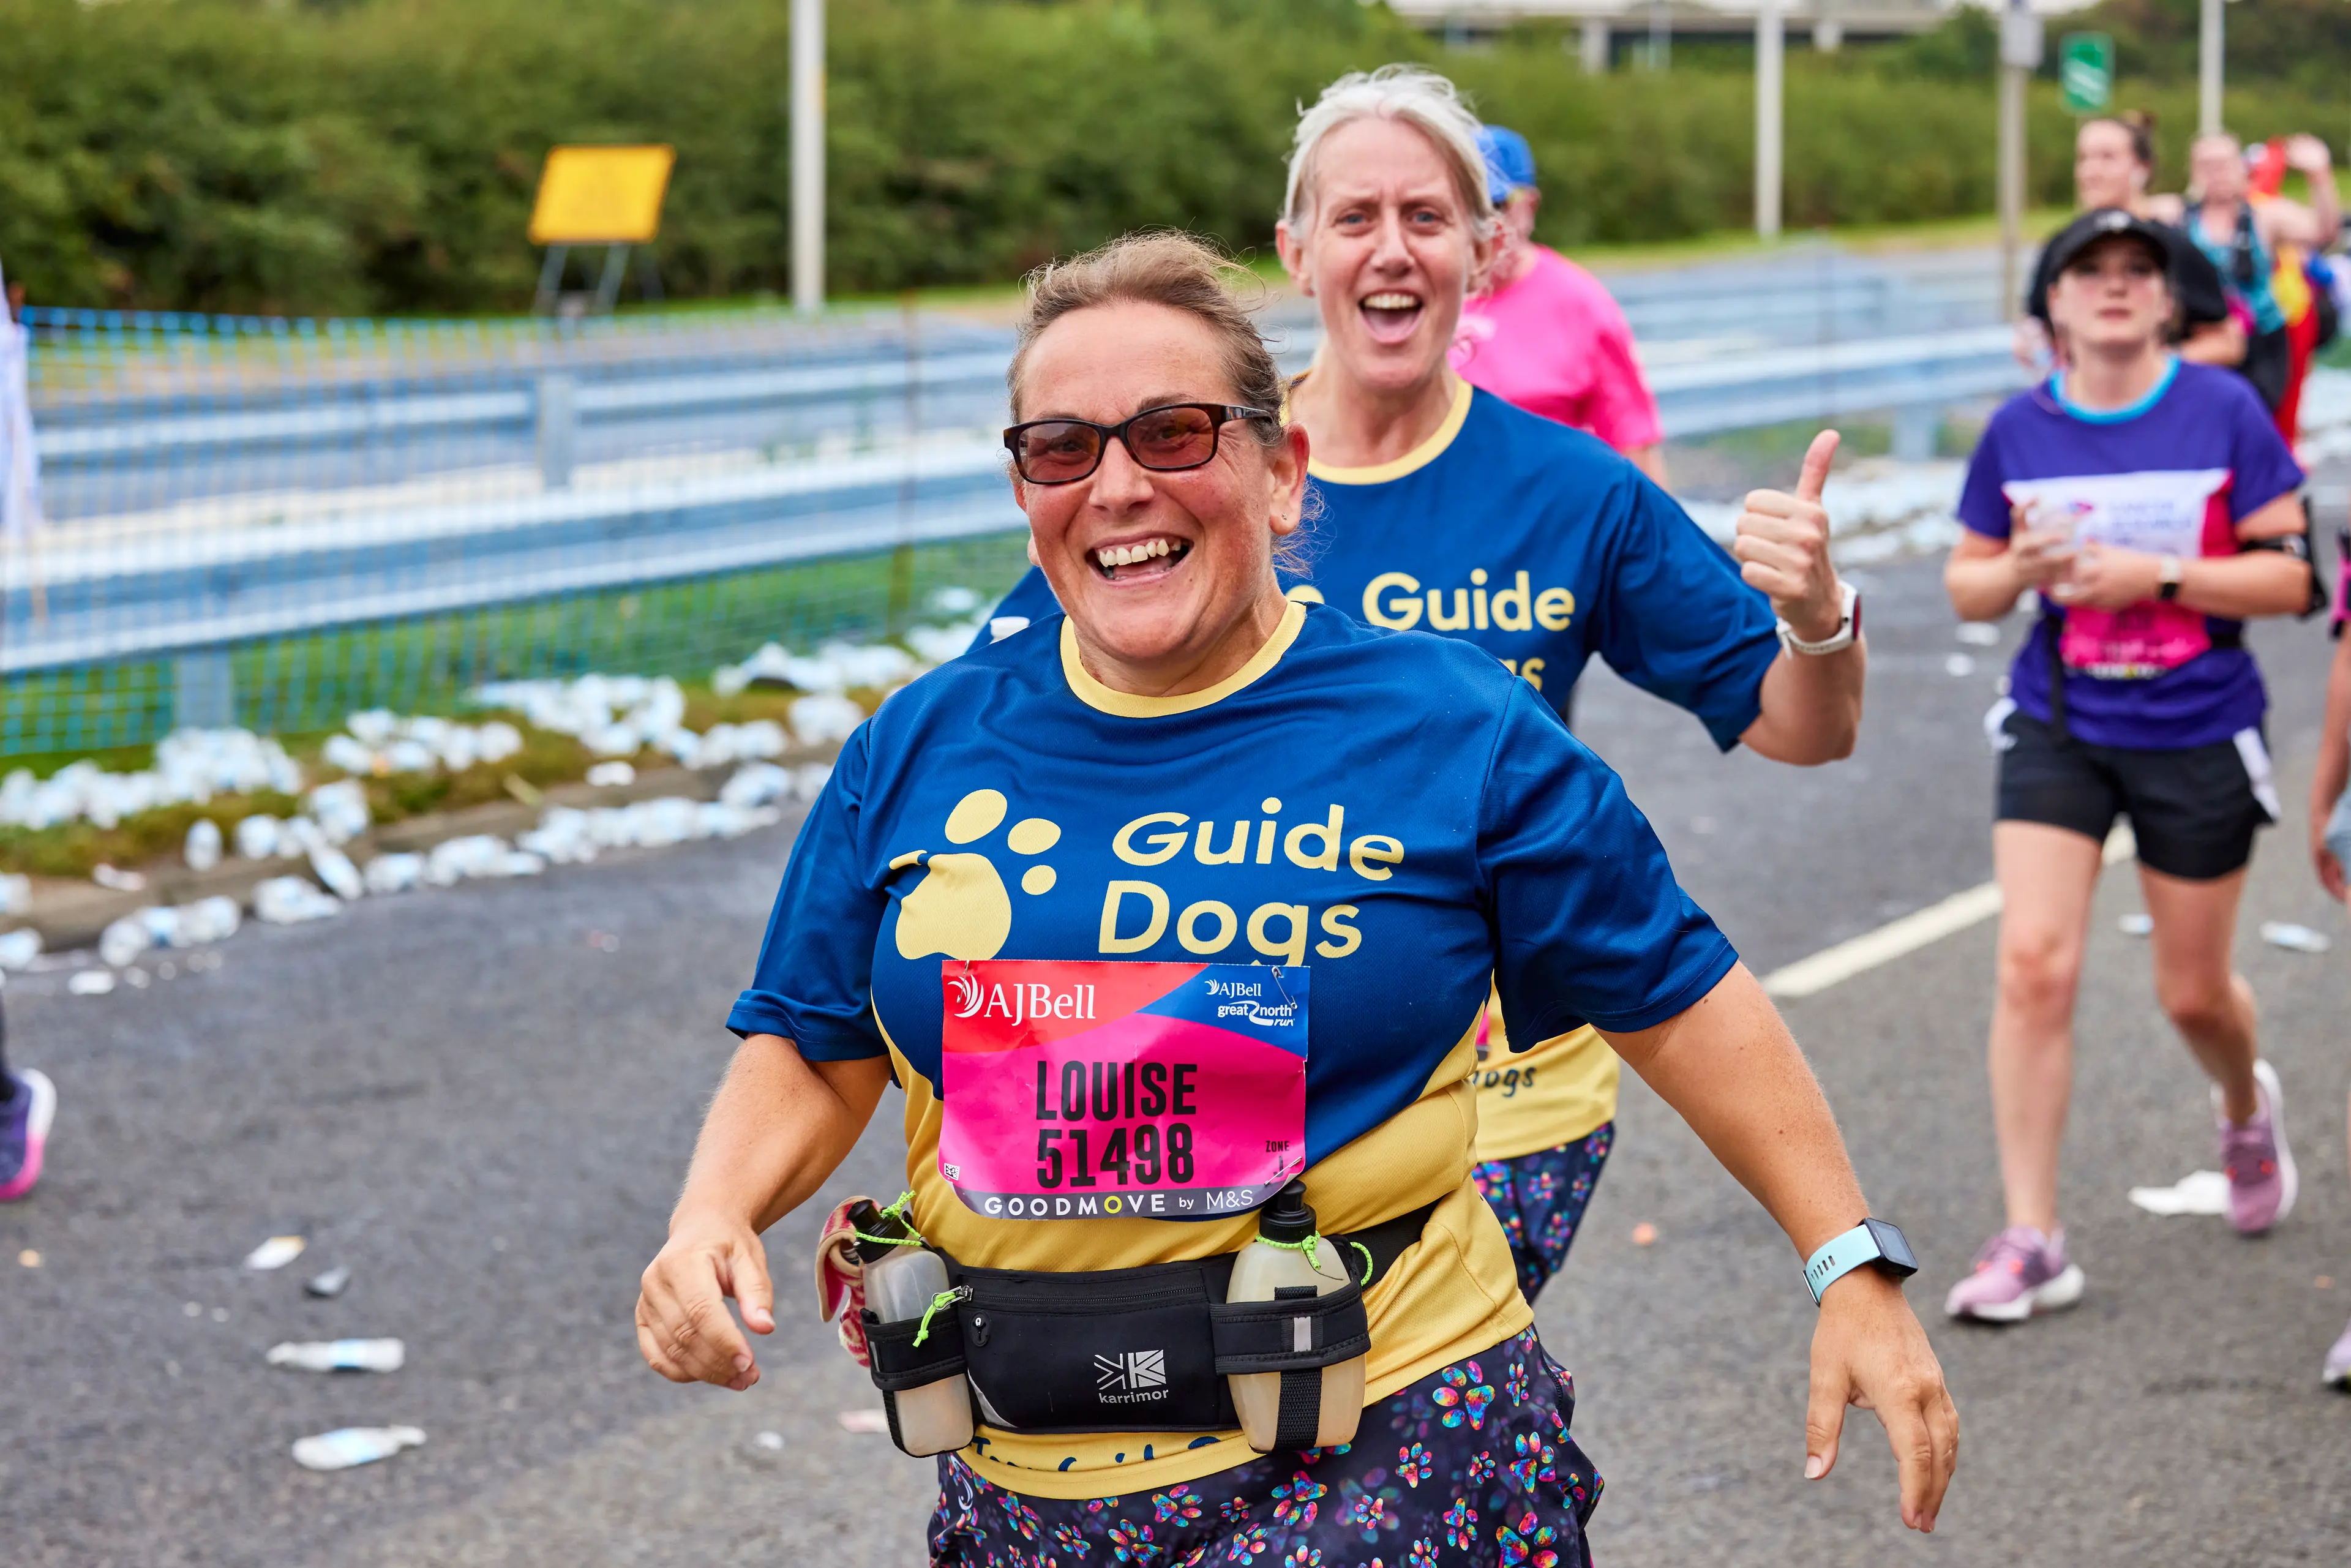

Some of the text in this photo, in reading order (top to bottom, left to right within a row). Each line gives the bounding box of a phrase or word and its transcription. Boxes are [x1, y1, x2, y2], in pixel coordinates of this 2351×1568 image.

[1362, 568, 1575, 632] Guide
[1112, 797, 1404, 882] Guide
[1098, 879, 1363, 966] Dogs
[1217, 1003, 1292, 1018] great north
[1273, 1018, 1294, 1027] run
[1035, 1060, 1198, 1122] LOUISE
[1037, 1123, 1194, 1189] 51498
[1265, 1140, 1290, 1152] ZONE
[984, 1189, 1254, 1216] GOODMOVE by M&S
[1098, 1389, 1169, 1403] karrimor
